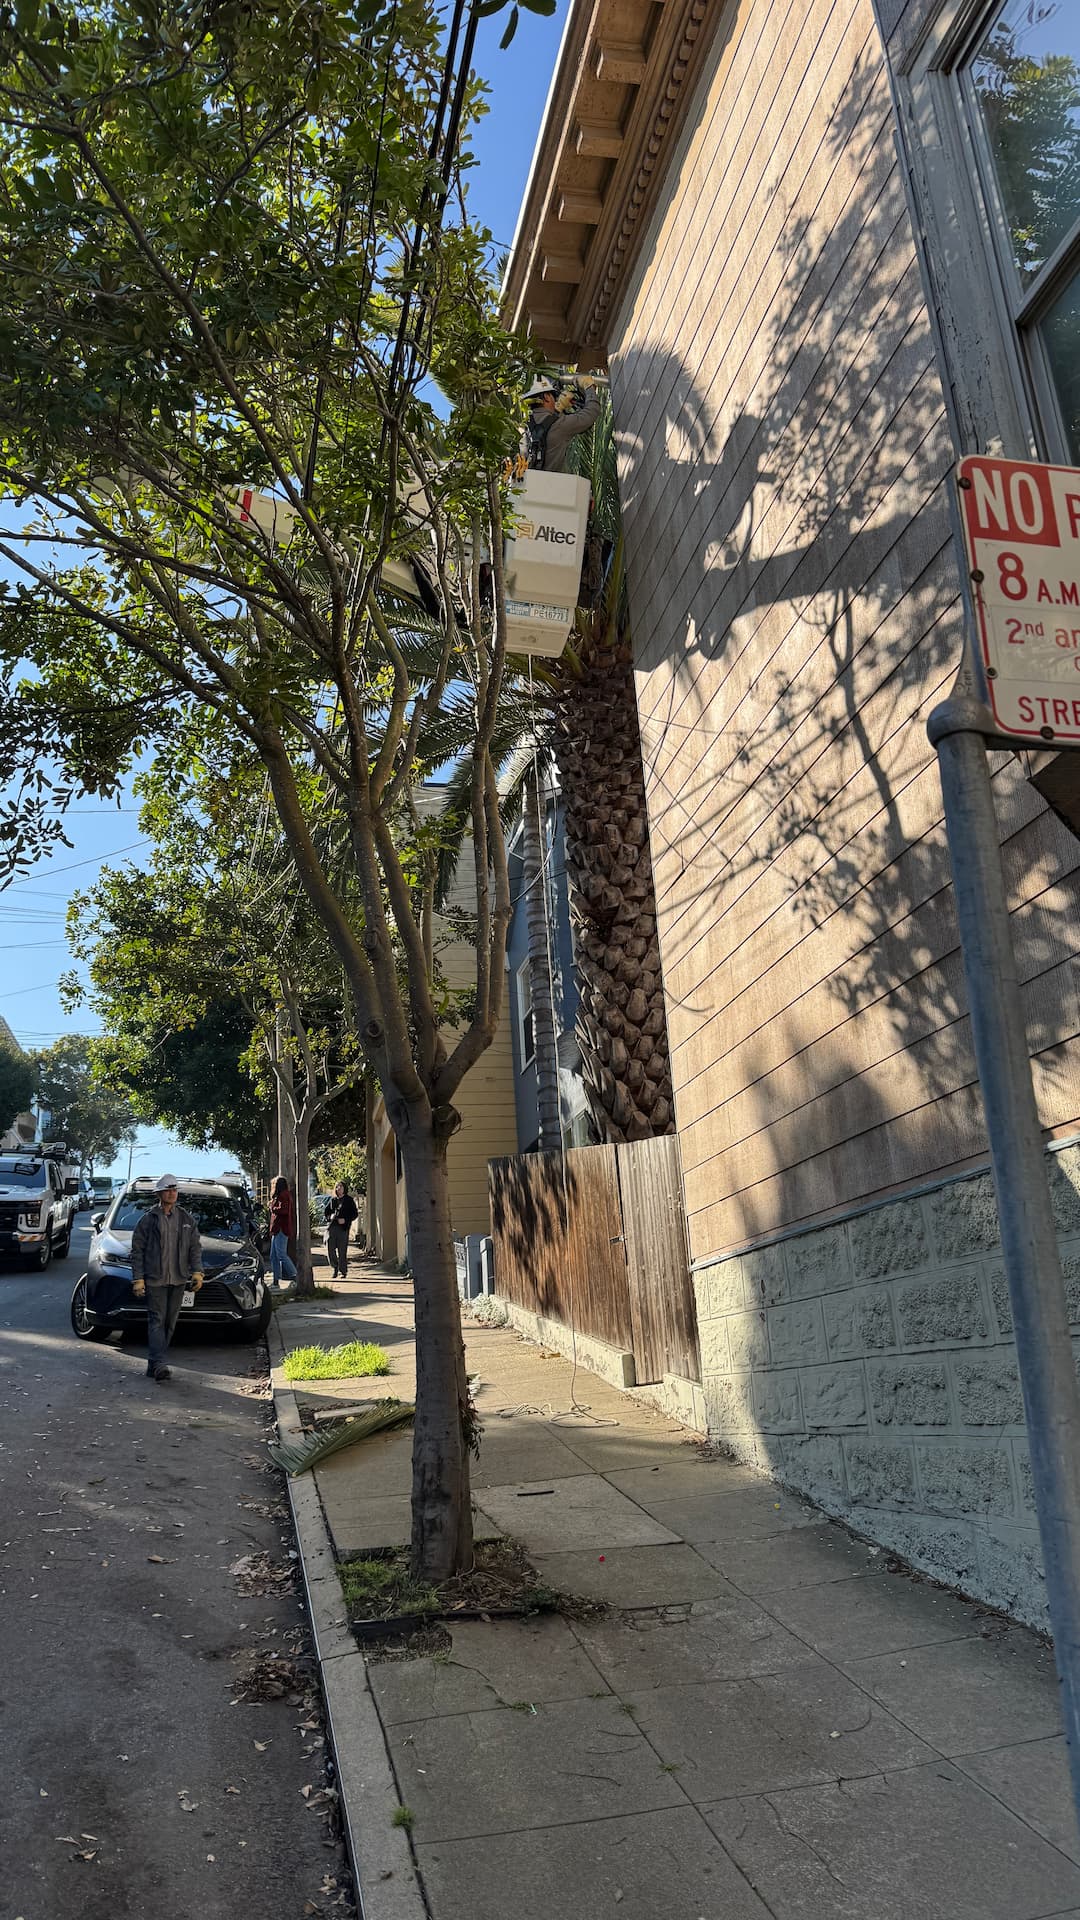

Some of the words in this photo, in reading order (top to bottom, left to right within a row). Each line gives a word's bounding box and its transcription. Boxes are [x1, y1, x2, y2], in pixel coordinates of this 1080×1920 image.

[972, 468, 1044, 535] NO
[534, 525, 576, 545] Altec
[997, 551, 1028, 601] 8
[1005, 618, 1045, 645] 2nd
